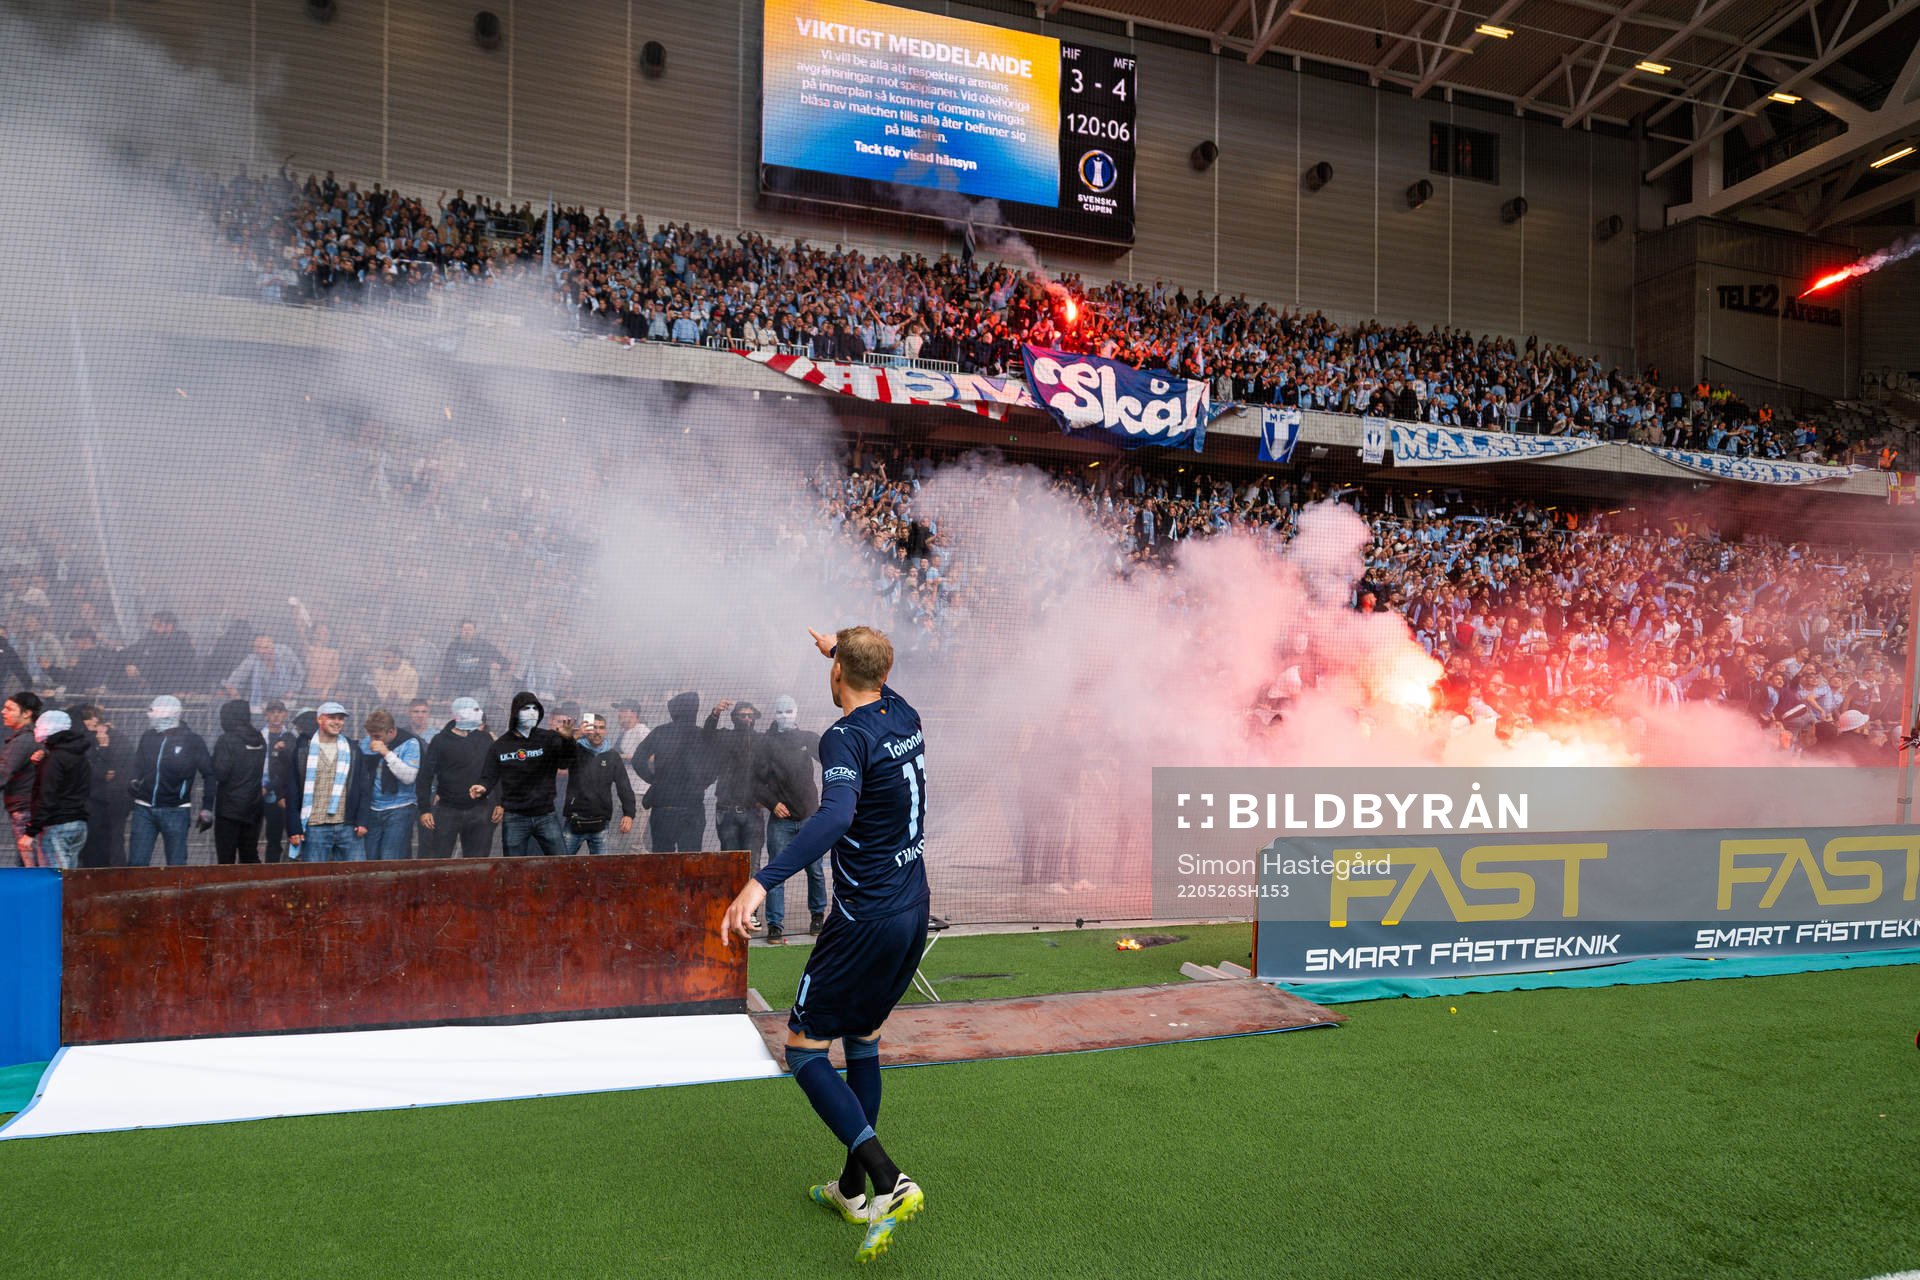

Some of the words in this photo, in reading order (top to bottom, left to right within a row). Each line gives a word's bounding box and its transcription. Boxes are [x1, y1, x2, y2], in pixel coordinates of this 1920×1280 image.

[795, 16, 884, 50] VIKTIGT
[888, 33, 1032, 78] MEDDELANDE
[1062, 47, 1081, 60] HIF
[1113, 57, 1136, 71] MFF
[797, 62, 877, 84] avgränsningar
[876, 77, 898, 88] mot
[900, 79, 958, 99] spelplanen.
[960, 89, 977, 101] Vid
[979, 95, 1030, 112] obehöriga
[820, 49, 832, 59] Vi
[835, 52, 851, 64] vill
[853, 54, 868, 67] be
[870, 58, 889, 71] alla
[890, 63, 907, 74] att
[908, 66, 965, 84] respektera
[968, 77, 1009, 92] arenans
[1070, 69, 1084, 94] 3
[1112, 78, 1127, 101] 4
[802, 78, 816, 90] på
[819, 80, 872, 98] innerplan
[875, 90, 887, 101] så
[889, 92, 935, 110] kommer
[937, 102, 985, 119] domarna
[988, 110, 1025, 126] tvingas
[832, 100, 846, 110] av
[849, 103, 897, 118] matchen
[900, 110, 919, 123] tills
[921, 114, 939, 126] alla
[941, 116, 963, 129] åter
[965, 121, 1010, 137] befinner
[1011, 130, 1026, 143] sig
[885, 122, 899, 136] på
[901, 125, 948, 143] läktaren.
[1067, 113, 1130, 142] 120:06
[854, 140, 882, 155] Tack
[883, 145, 901, 158] för
[903, 149, 934, 162] visad
[935, 153, 977, 171] hänsyn
[1078, 194, 1117, 207] SVENSKA
[1083, 203, 1112, 214] CUPEN
[1717, 284, 1779, 317] TELE2
[1782, 296, 1841, 326] Arena
[1329, 842, 1608, 928] FAST
[1716, 835, 1920, 910] FAST
[1305, 944, 1422, 972] SMART
[1430, 934, 1621, 966] FÄSTTEKNIK
[1695, 925, 1790, 949] SMART
